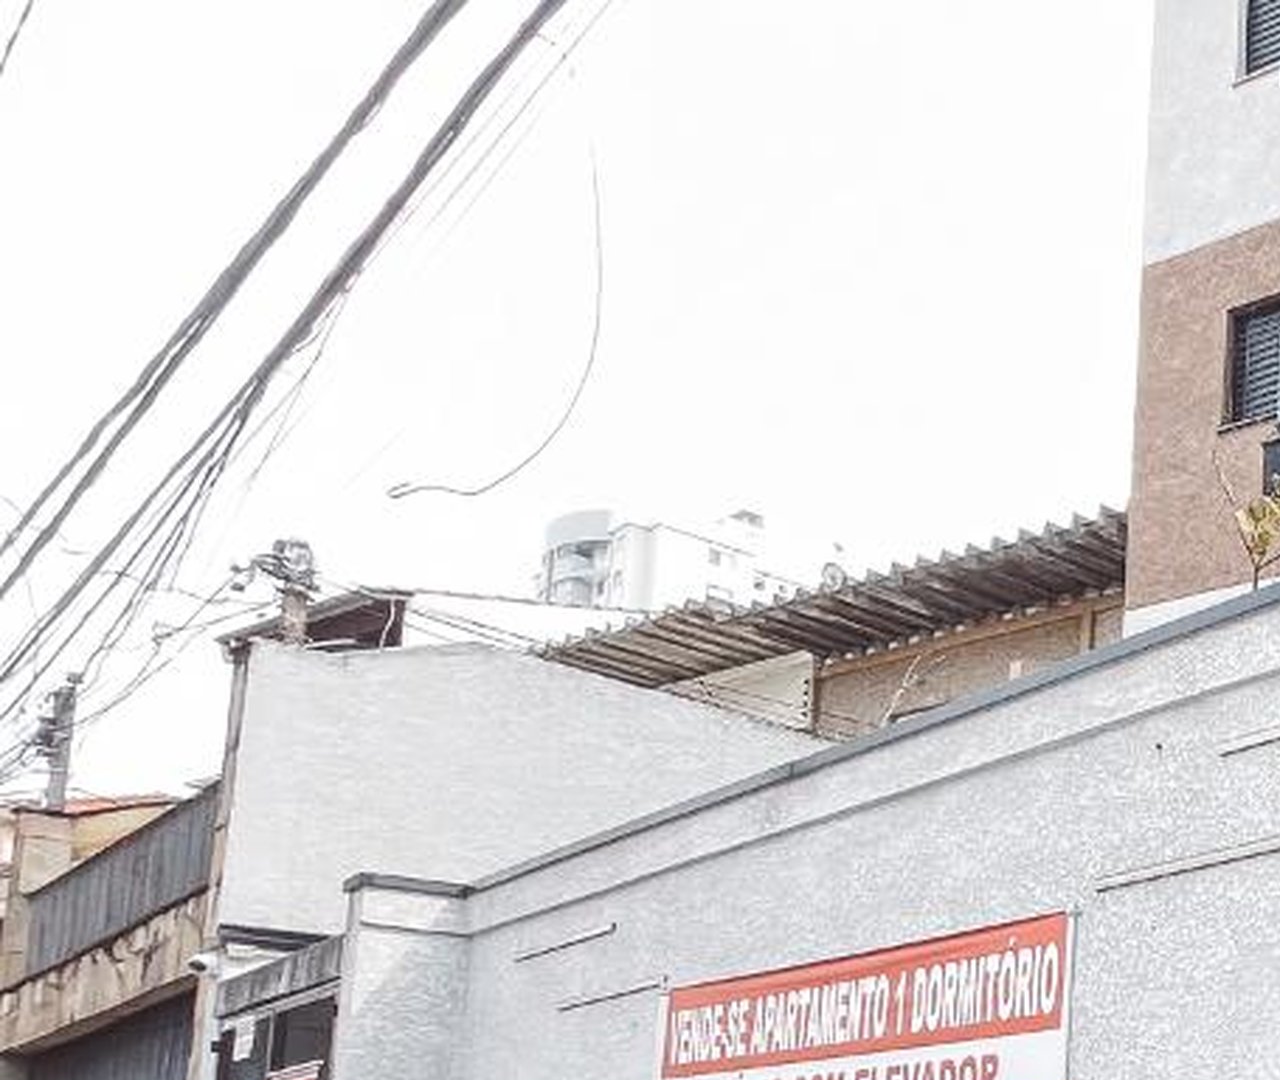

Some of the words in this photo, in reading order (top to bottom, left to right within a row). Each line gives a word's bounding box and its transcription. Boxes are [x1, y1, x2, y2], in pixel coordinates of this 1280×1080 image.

[752, 973, 890, 1055] APARTAMENTO
[896, 970, 907, 1036] 1
[911, 937, 1059, 1034] DORMITÓRIO
